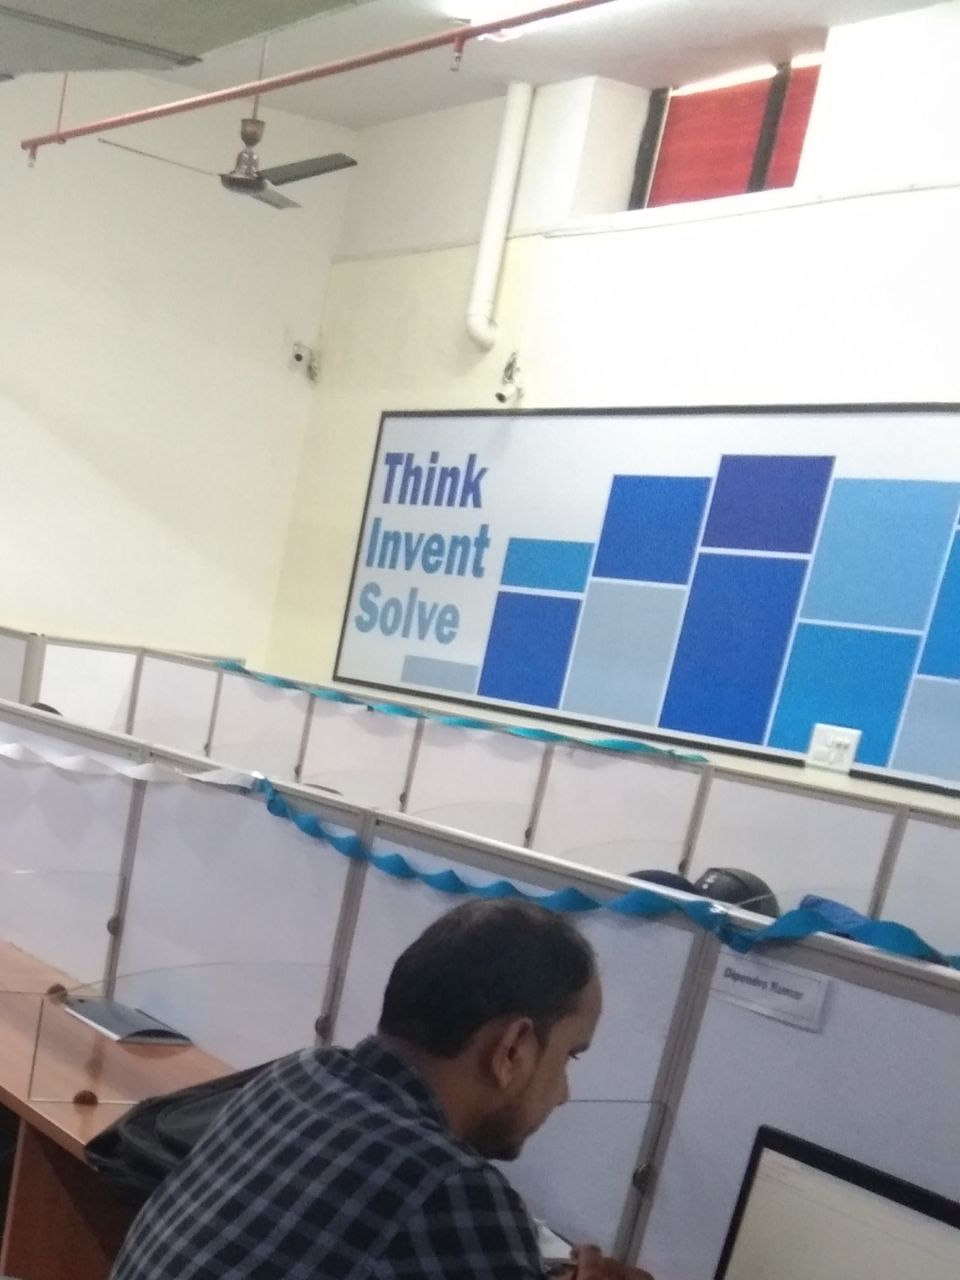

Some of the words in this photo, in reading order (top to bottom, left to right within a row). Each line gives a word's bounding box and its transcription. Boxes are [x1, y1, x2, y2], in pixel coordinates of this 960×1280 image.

[381, 451, 489, 509] Think
[365, 516, 492, 578] Invent
[354, 581, 461, 645] Solve
